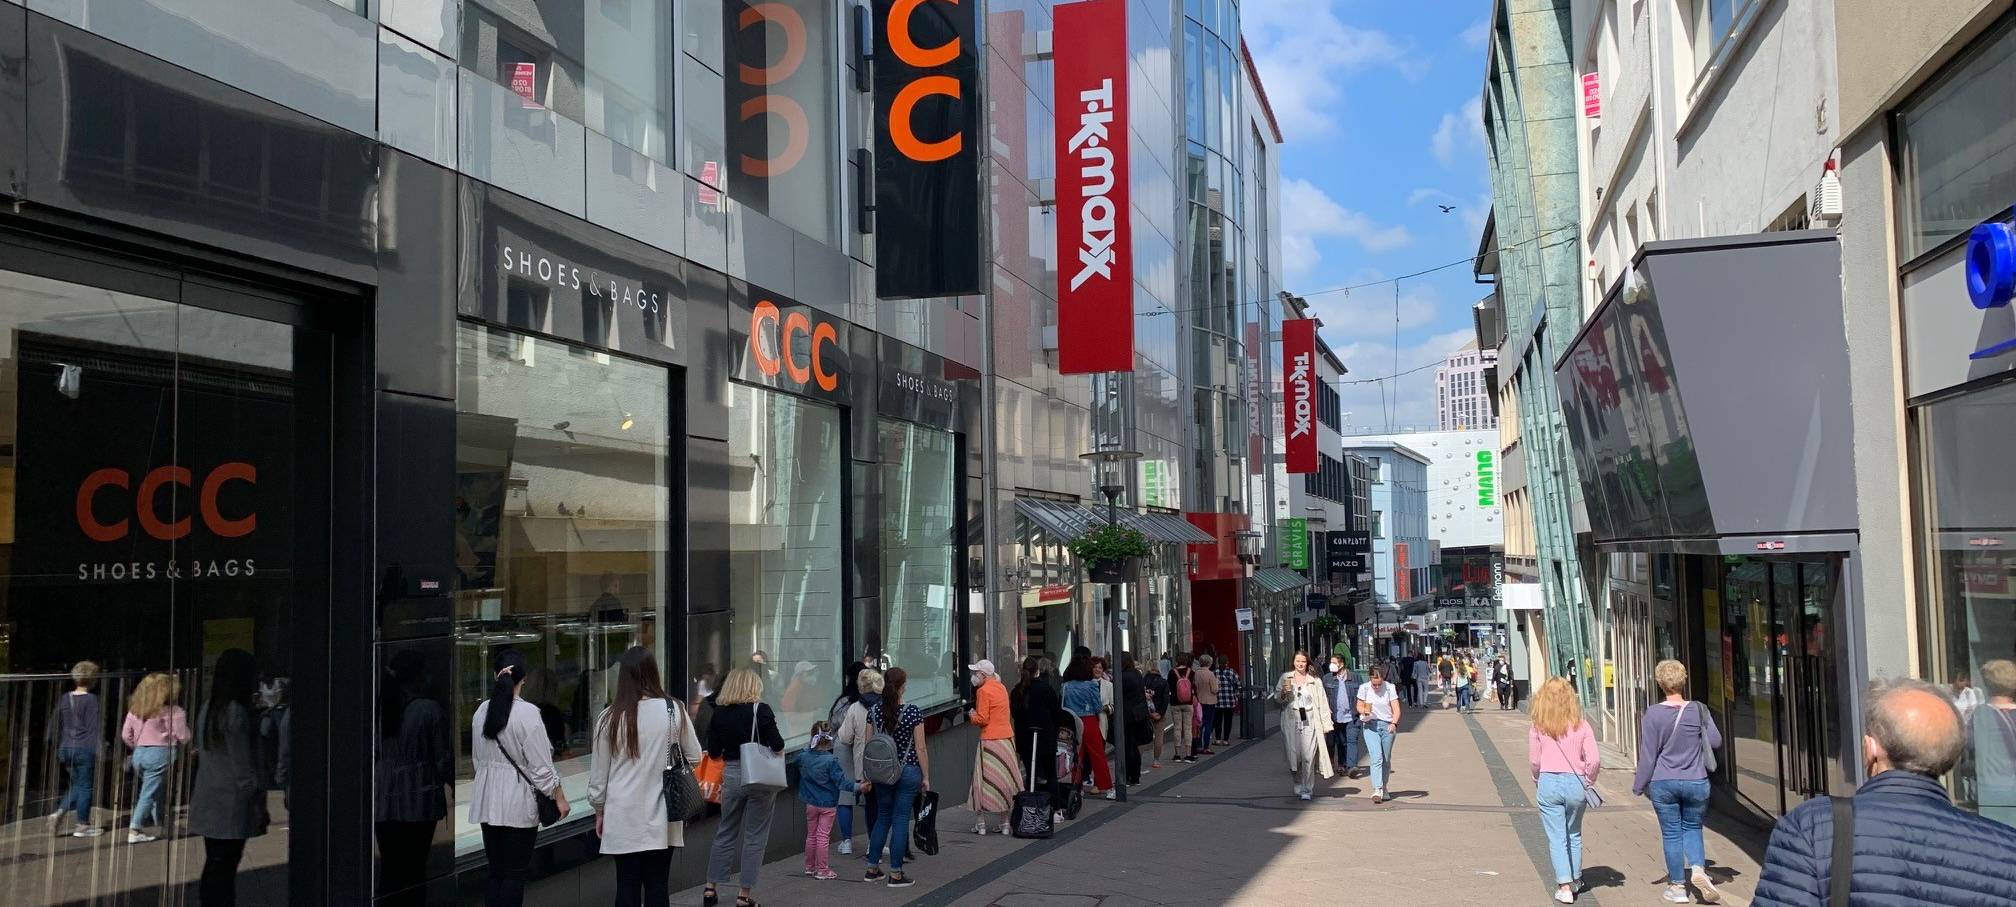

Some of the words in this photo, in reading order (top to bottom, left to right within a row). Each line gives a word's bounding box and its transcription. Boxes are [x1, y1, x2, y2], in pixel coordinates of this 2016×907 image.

[503, 246, 581, 290] SHOES
[589, 271, 602, 298] &
[610, 280, 659, 314] BAGS
[751, 301, 838, 391] CCC
[896, 372, 924, 394] SHOES
[933, 384, 953, 402] BAGS
[76, 462, 257, 542] CCC
[1292, 519, 1303, 567] GRAVIS
[78, 562, 156, 580] SHOES
[166, 559, 182, 579] &
[192, 558, 256, 577] BAGS
[1493, 562, 1502, 601] fielmann
[1439, 598, 1463, 607] IQOS
